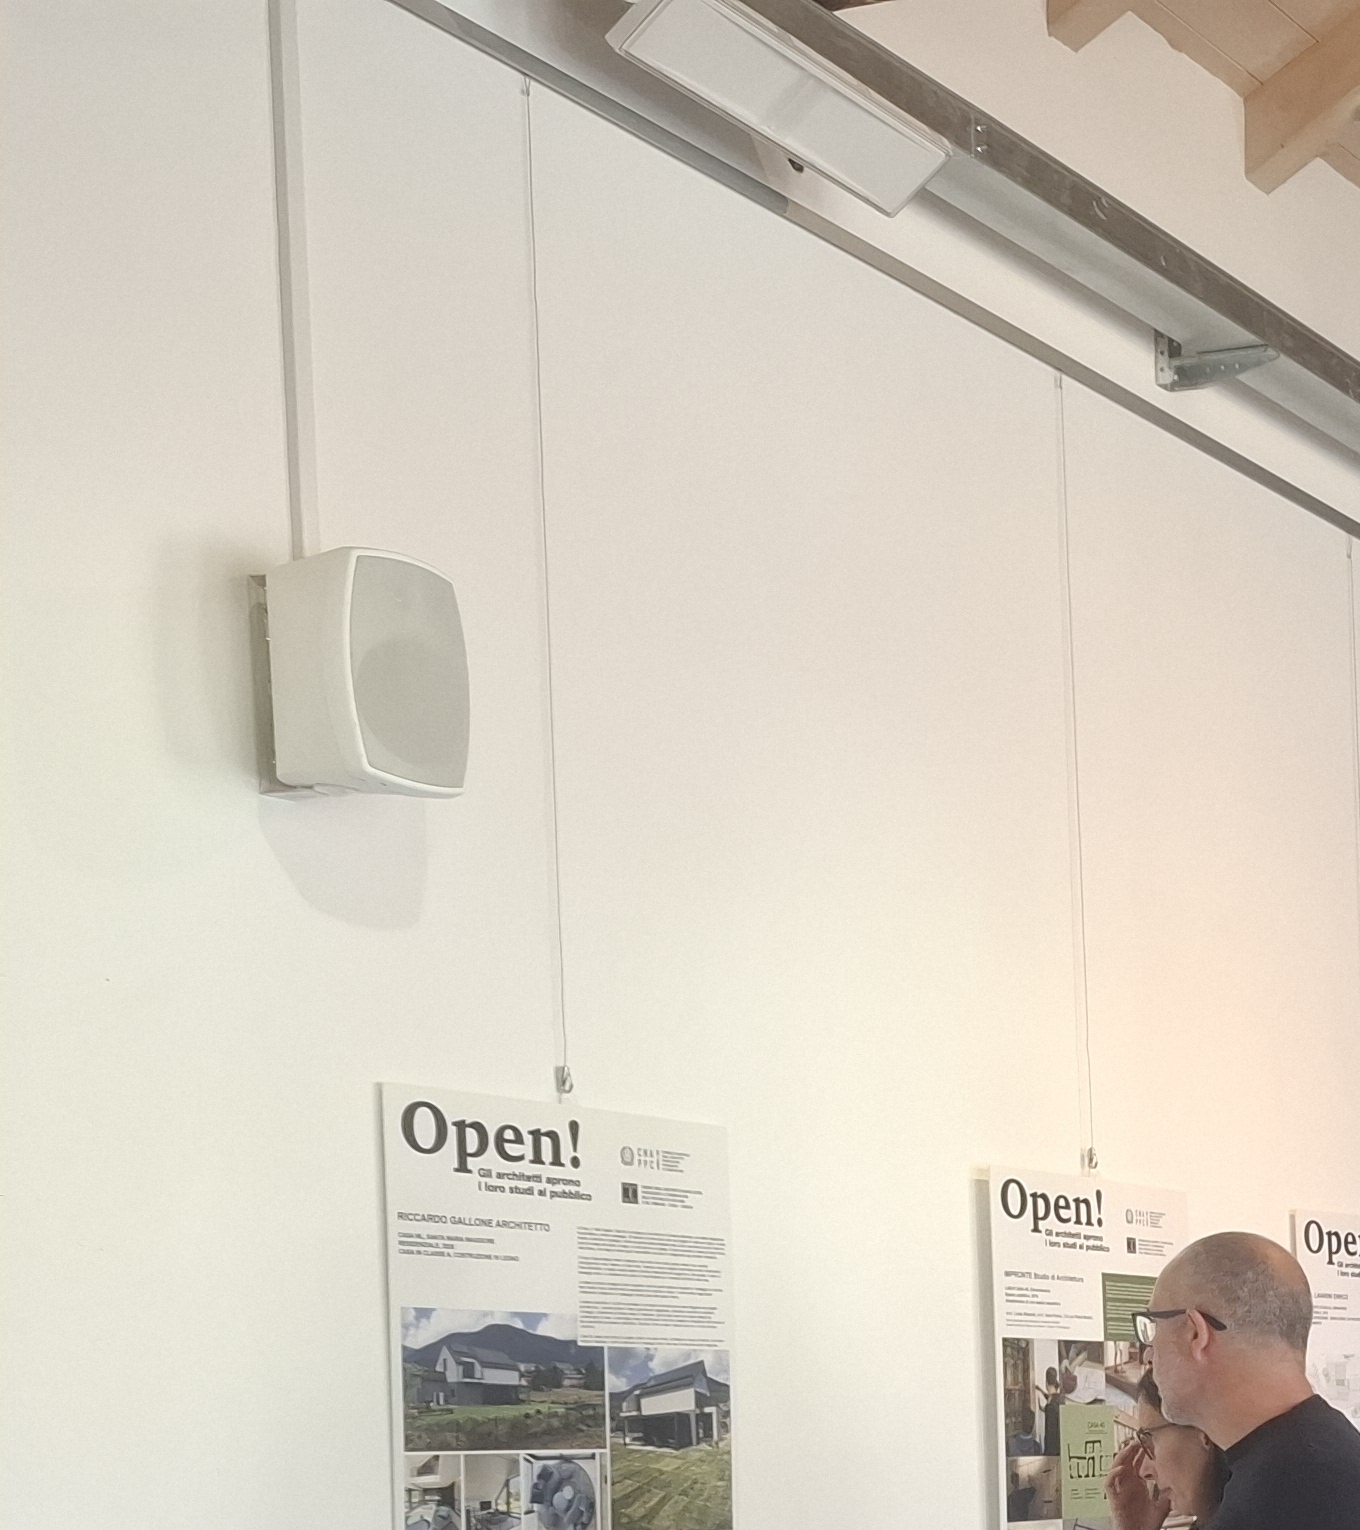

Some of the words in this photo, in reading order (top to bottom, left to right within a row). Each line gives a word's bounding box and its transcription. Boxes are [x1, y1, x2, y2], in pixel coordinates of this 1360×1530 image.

[401, 1100, 581, 1174] Open!
[484, 1181, 506, 1193] loro
[508, 1185, 535, 1196] studi
[549, 1189, 593, 1201] pubblico
[545, 1176, 581, 1188] aprono
[1000, 1178, 1103, 1234] Open!
[397, 1211, 447, 1225] RICCARDO
[449, 1215, 494, 1228] GALLONE
[494, 1219, 551, 1233] ARCHITETTO
